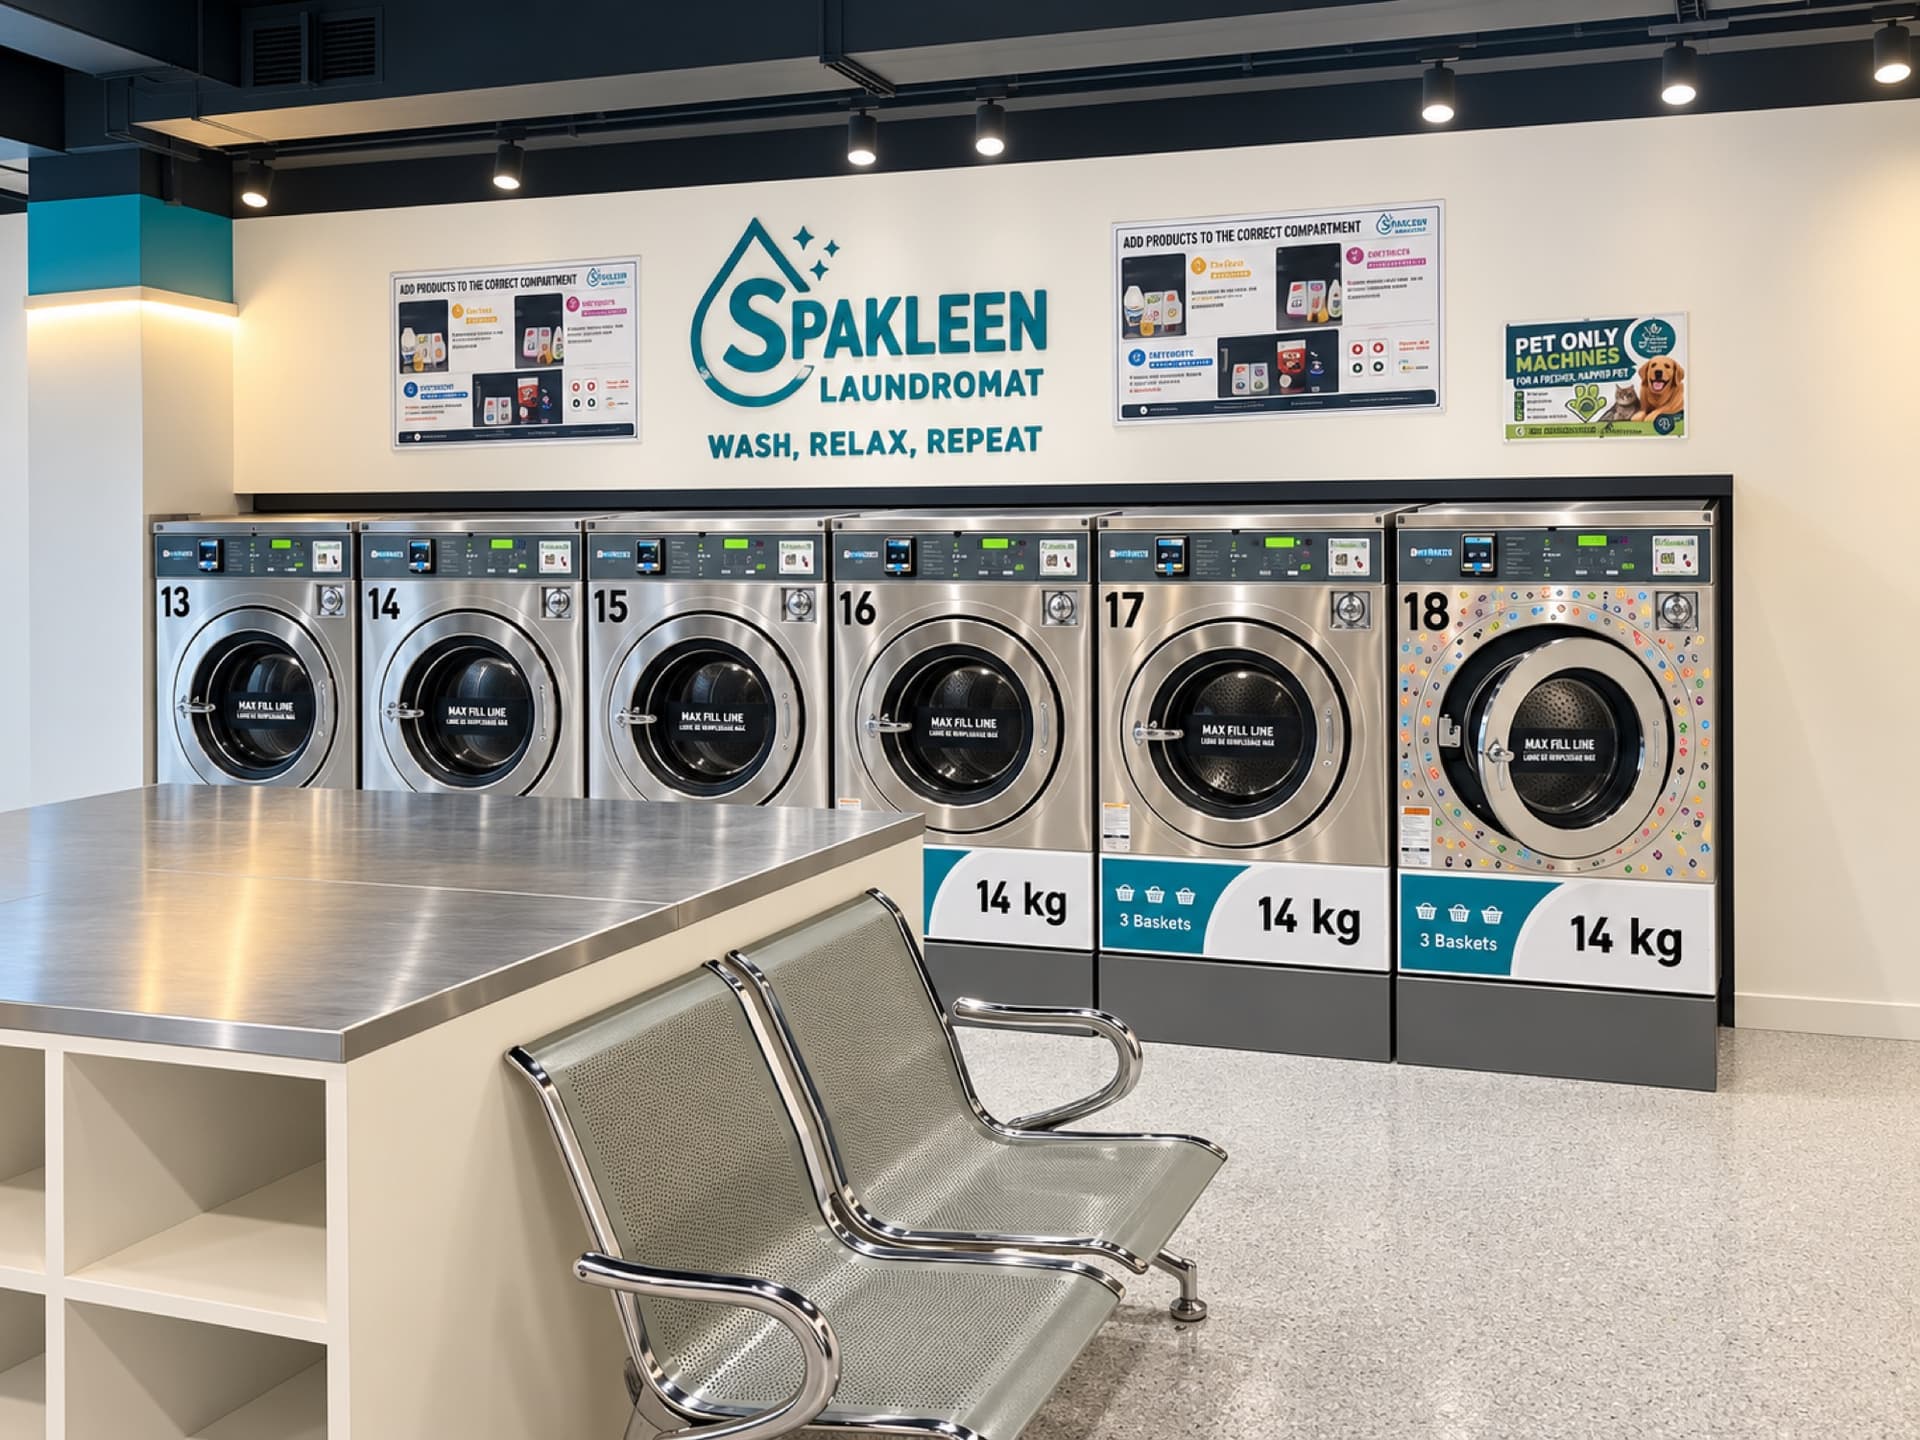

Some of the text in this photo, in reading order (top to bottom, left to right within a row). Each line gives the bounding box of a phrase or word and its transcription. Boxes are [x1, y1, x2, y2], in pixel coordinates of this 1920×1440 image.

[1123, 221, 1361, 248] ADD PRODUCTS TO THE CORRECT COMPARTMENT
[400, 284, 415, 295] ADD
[417, 281, 455, 294] PRODUCTS
[458, 281, 467, 291] TO
[469, 280, 483, 290] THE
[485, 277, 518, 289] CORRECT
[723, 278, 1047, 372] SPAKLEEN
[1515, 334, 1556, 355] PET
[1561, 327, 1619, 350] ONLY
[1516, 347, 1620, 373] MACHINES
[820, 368, 1044, 403] LAUNDROMAT
[708, 425, 1043, 461] WASH, RELAX, REPEAT
[161, 586, 189, 617] 13
[369, 588, 400, 619] 14
[595, 590, 627, 623] 15
[840, 591, 876, 625] 16
[1106, 592, 1144, 628] 17
[1404, 592, 1449, 631] 18
[239, 702, 293, 711] MAX FILL LINE
[449, 707, 505, 717] MAX FILL LINE
[682, 712, 743, 723] MAX FILL LINE
[932, 718, 996, 728] MAX FILL LINE
[1203, 725, 1273, 736] MAX FILL LINE
[1525, 739, 1594, 750] MAX FILL LINE
[977, 880, 1066, 925] 14 kg
[1120, 913, 1191, 930] 3 Baskets
[1259, 897, 1360, 945] 14 kg
[1421, 933, 1497, 951] 3 Baskets
[1571, 916, 1681, 967] 14 kg
